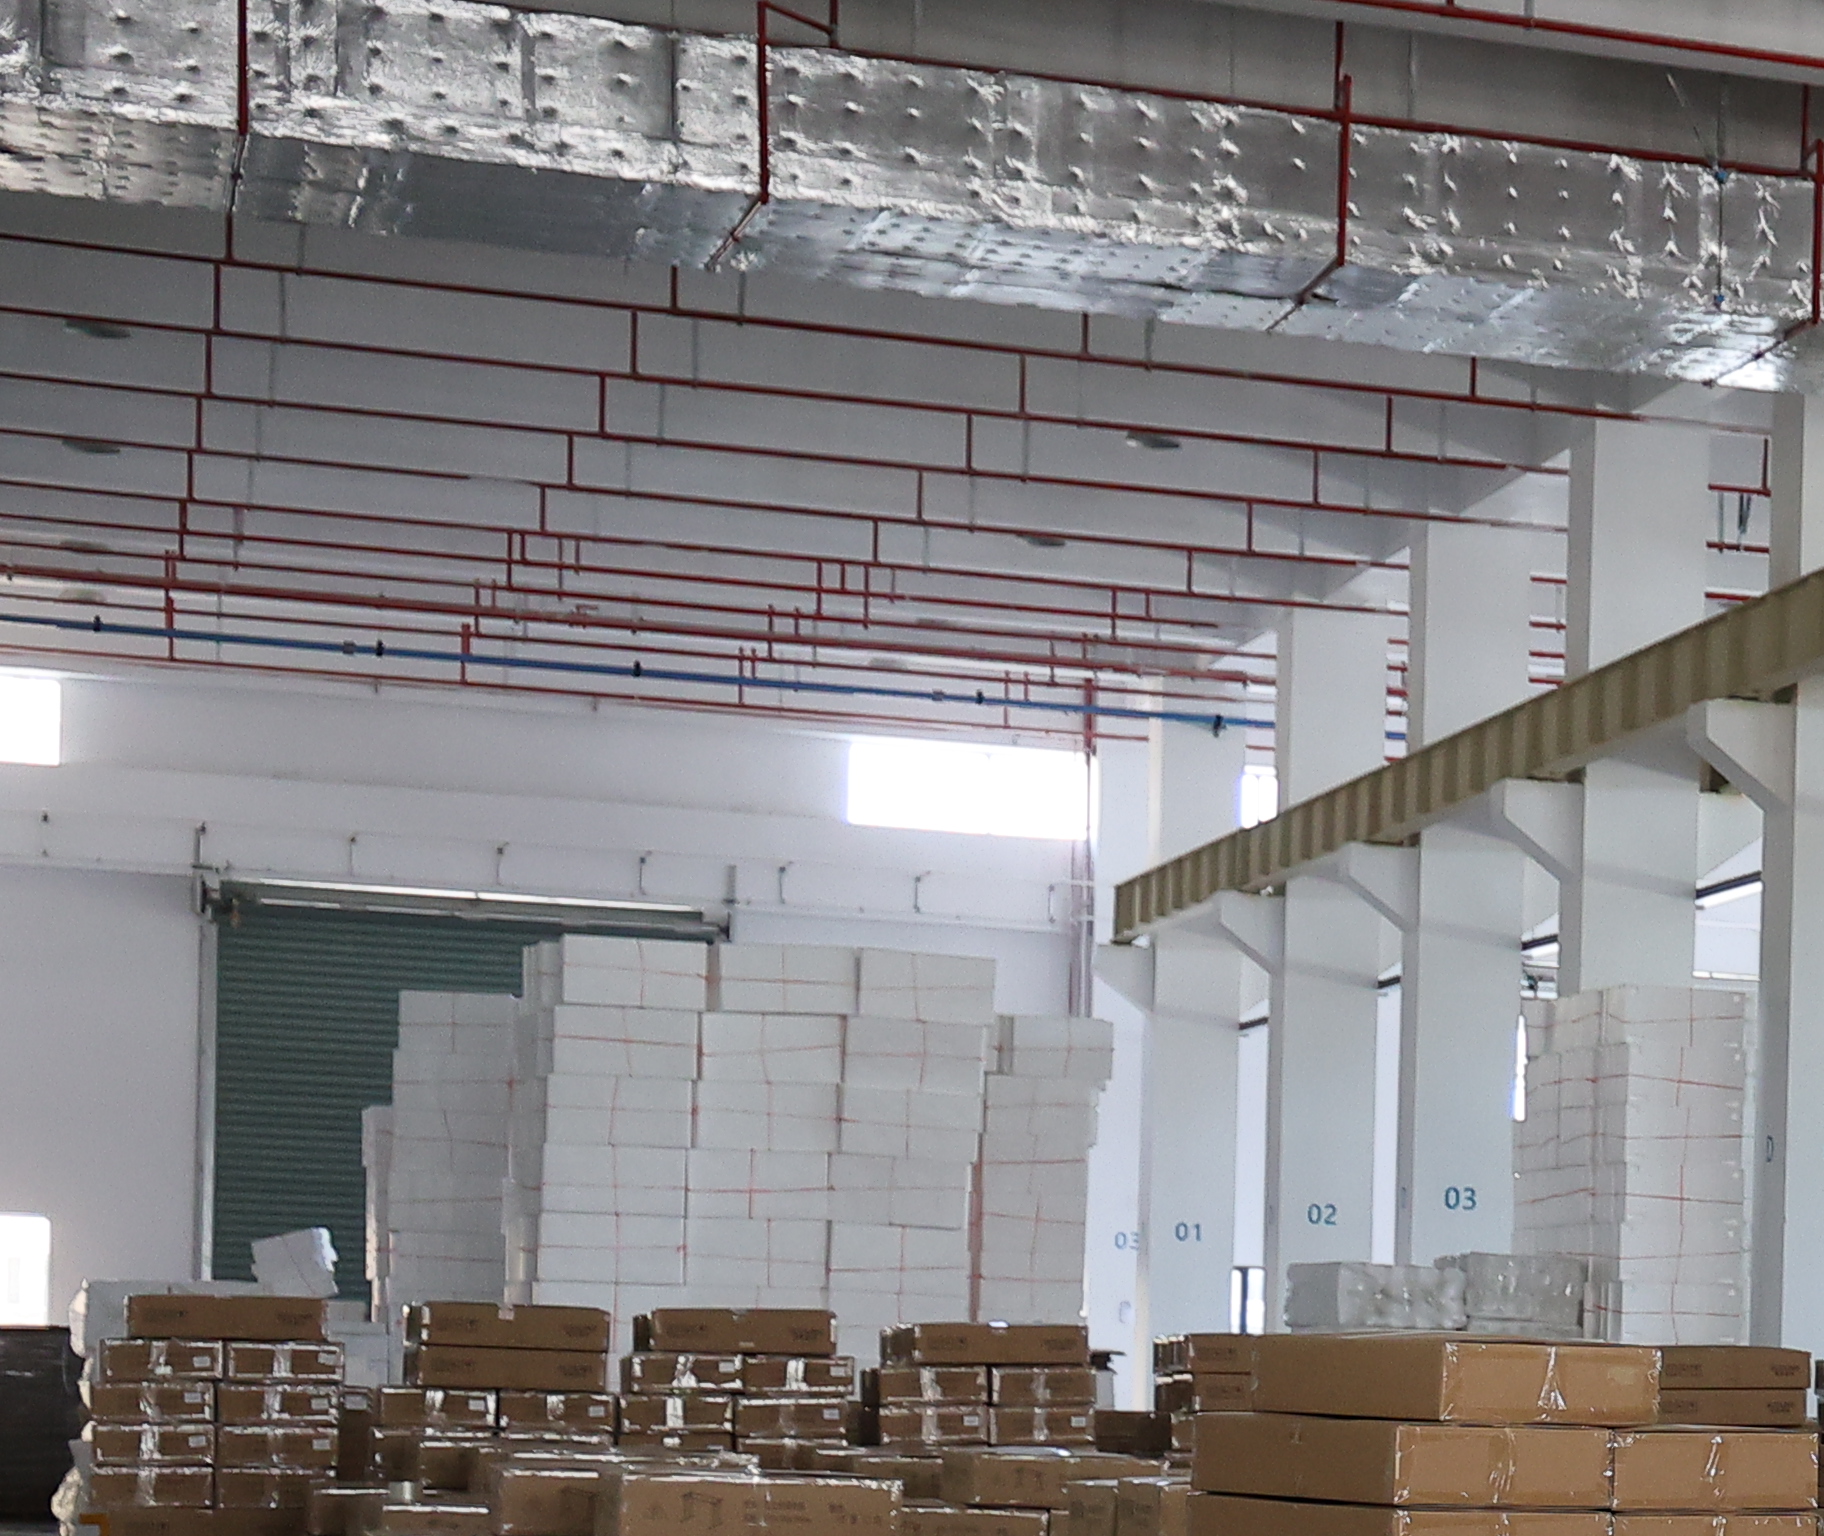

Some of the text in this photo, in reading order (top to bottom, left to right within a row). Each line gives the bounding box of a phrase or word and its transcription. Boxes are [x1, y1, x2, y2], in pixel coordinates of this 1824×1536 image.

[1444, 1187, 1477, 1211] 03
[1307, 1203, 1337, 1226] 02
[1175, 1221, 1203, 1243] 01
